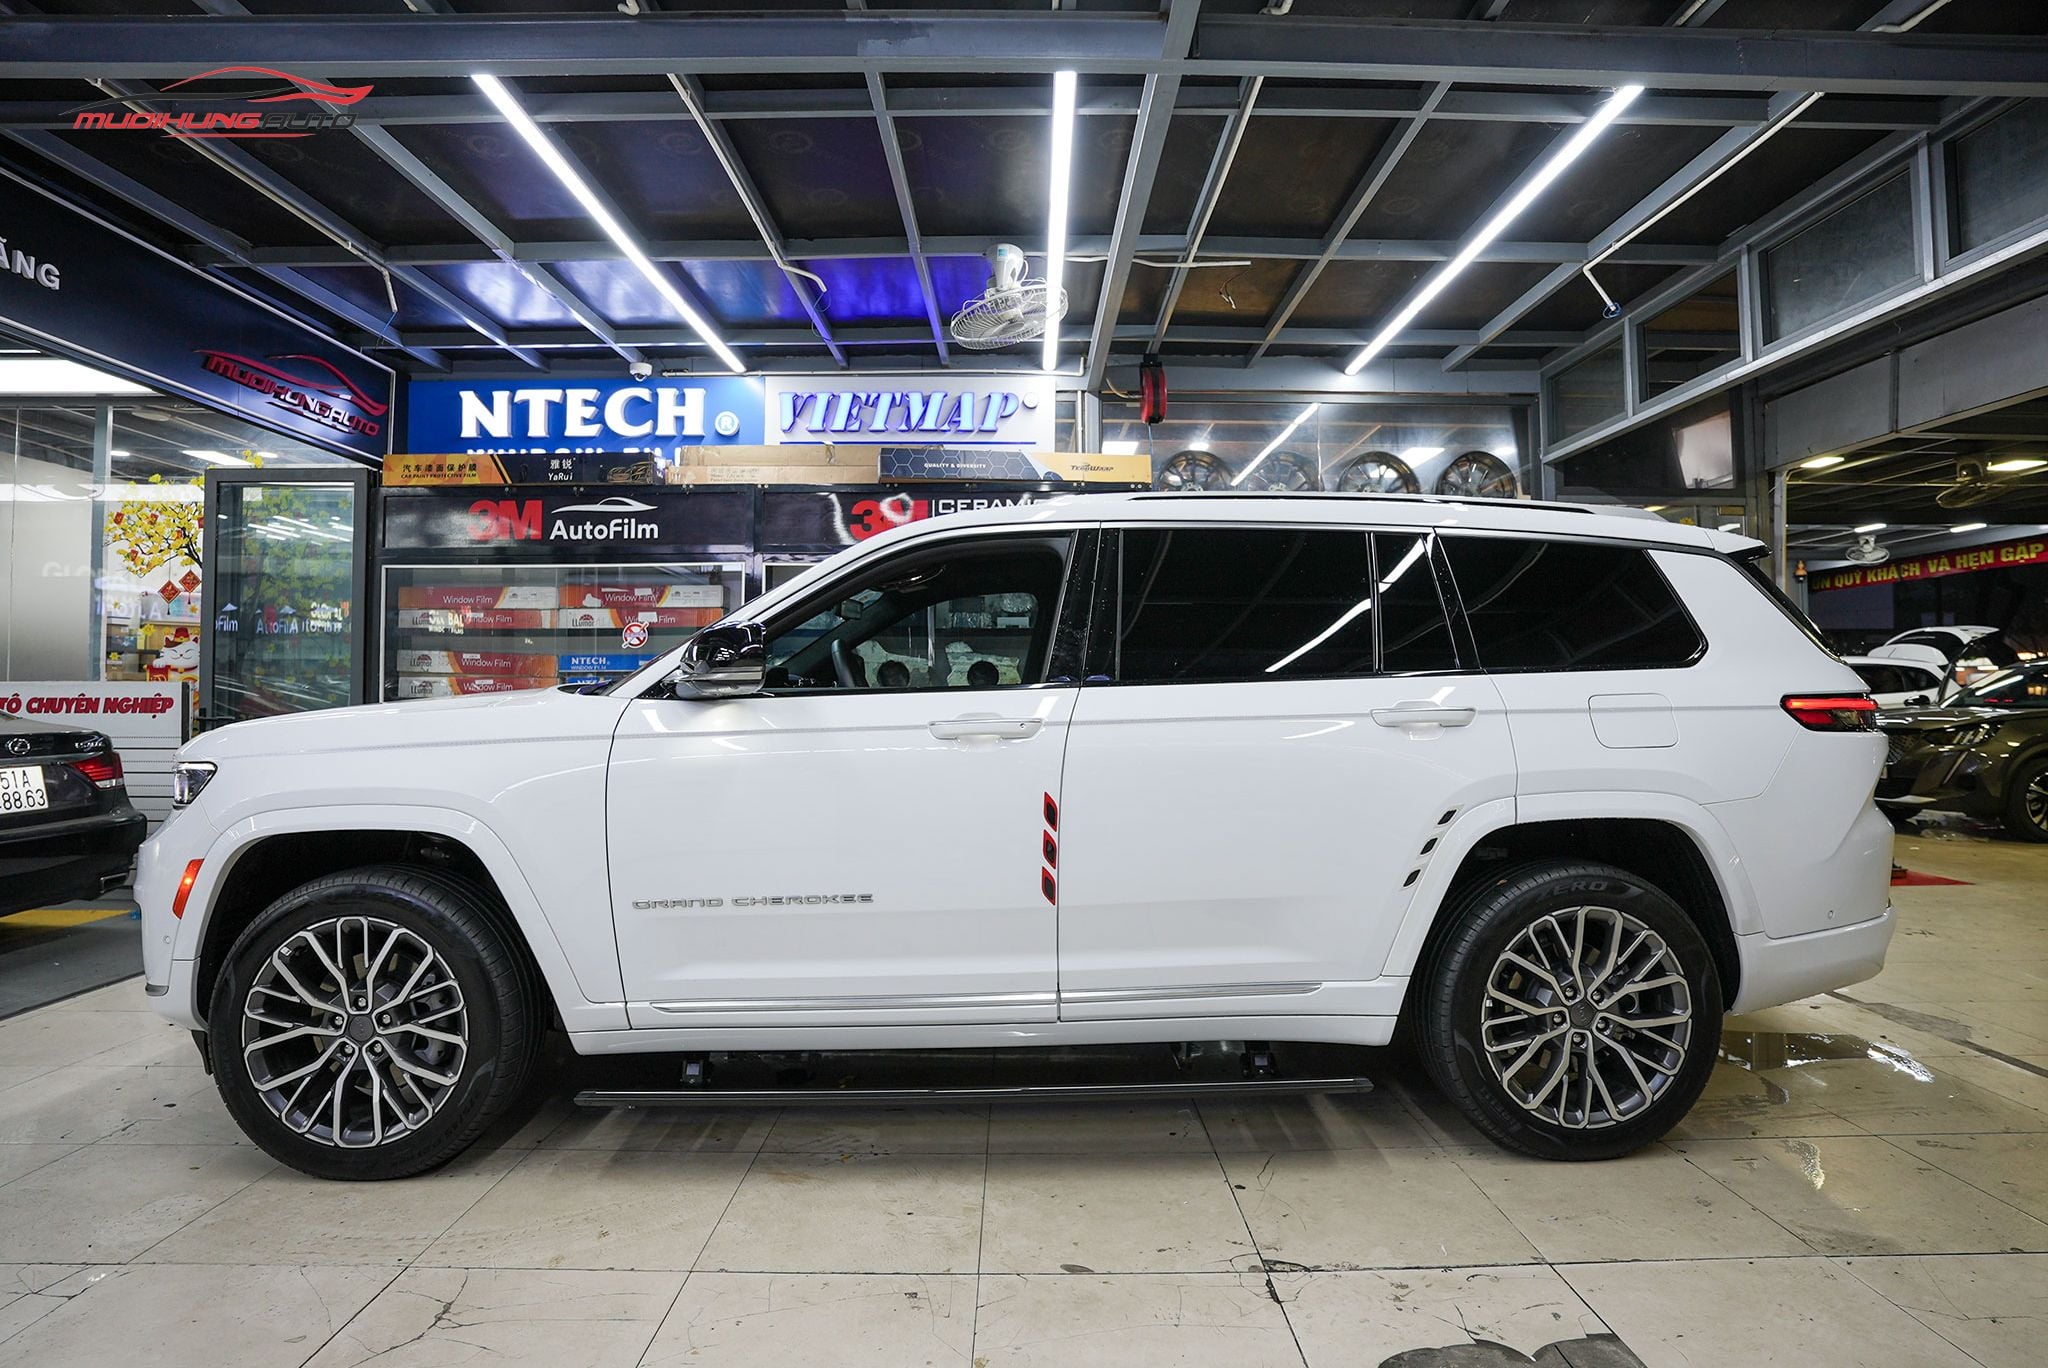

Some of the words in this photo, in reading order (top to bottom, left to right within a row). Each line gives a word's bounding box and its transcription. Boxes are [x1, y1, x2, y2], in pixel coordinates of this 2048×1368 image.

[459, 387, 706, 438] NTECH
[779, 391, 1020, 433] VIETMAP
[548, 472, 573, 481] YaRui
[468, 500, 543, 541] 3M
[550, 518, 659, 540] AutoFilm
[1955, 550, 1994, 570] HẸN
[443, 595, 474, 604] Window
[476, 595, 493, 604] Film
[605, 594, 636, 602] Window
[638, 594, 656, 602] Film
[496, 614, 512, 623] Film
[659, 615, 675, 624] Film
[462, 658, 492, 667] Window
[494, 658, 511, 668] Film
[571, 657, 606, 665] NTECH
[496, 683, 513, 691] Film
[26, 693, 100, 713] CHUYÊN
[103, 693, 174, 719] NGHIỆP
[0, 770, 31, 790] 51A
[632, 897, 723, 910] GRAND
[731, 893, 874, 907] CHEROKEE
